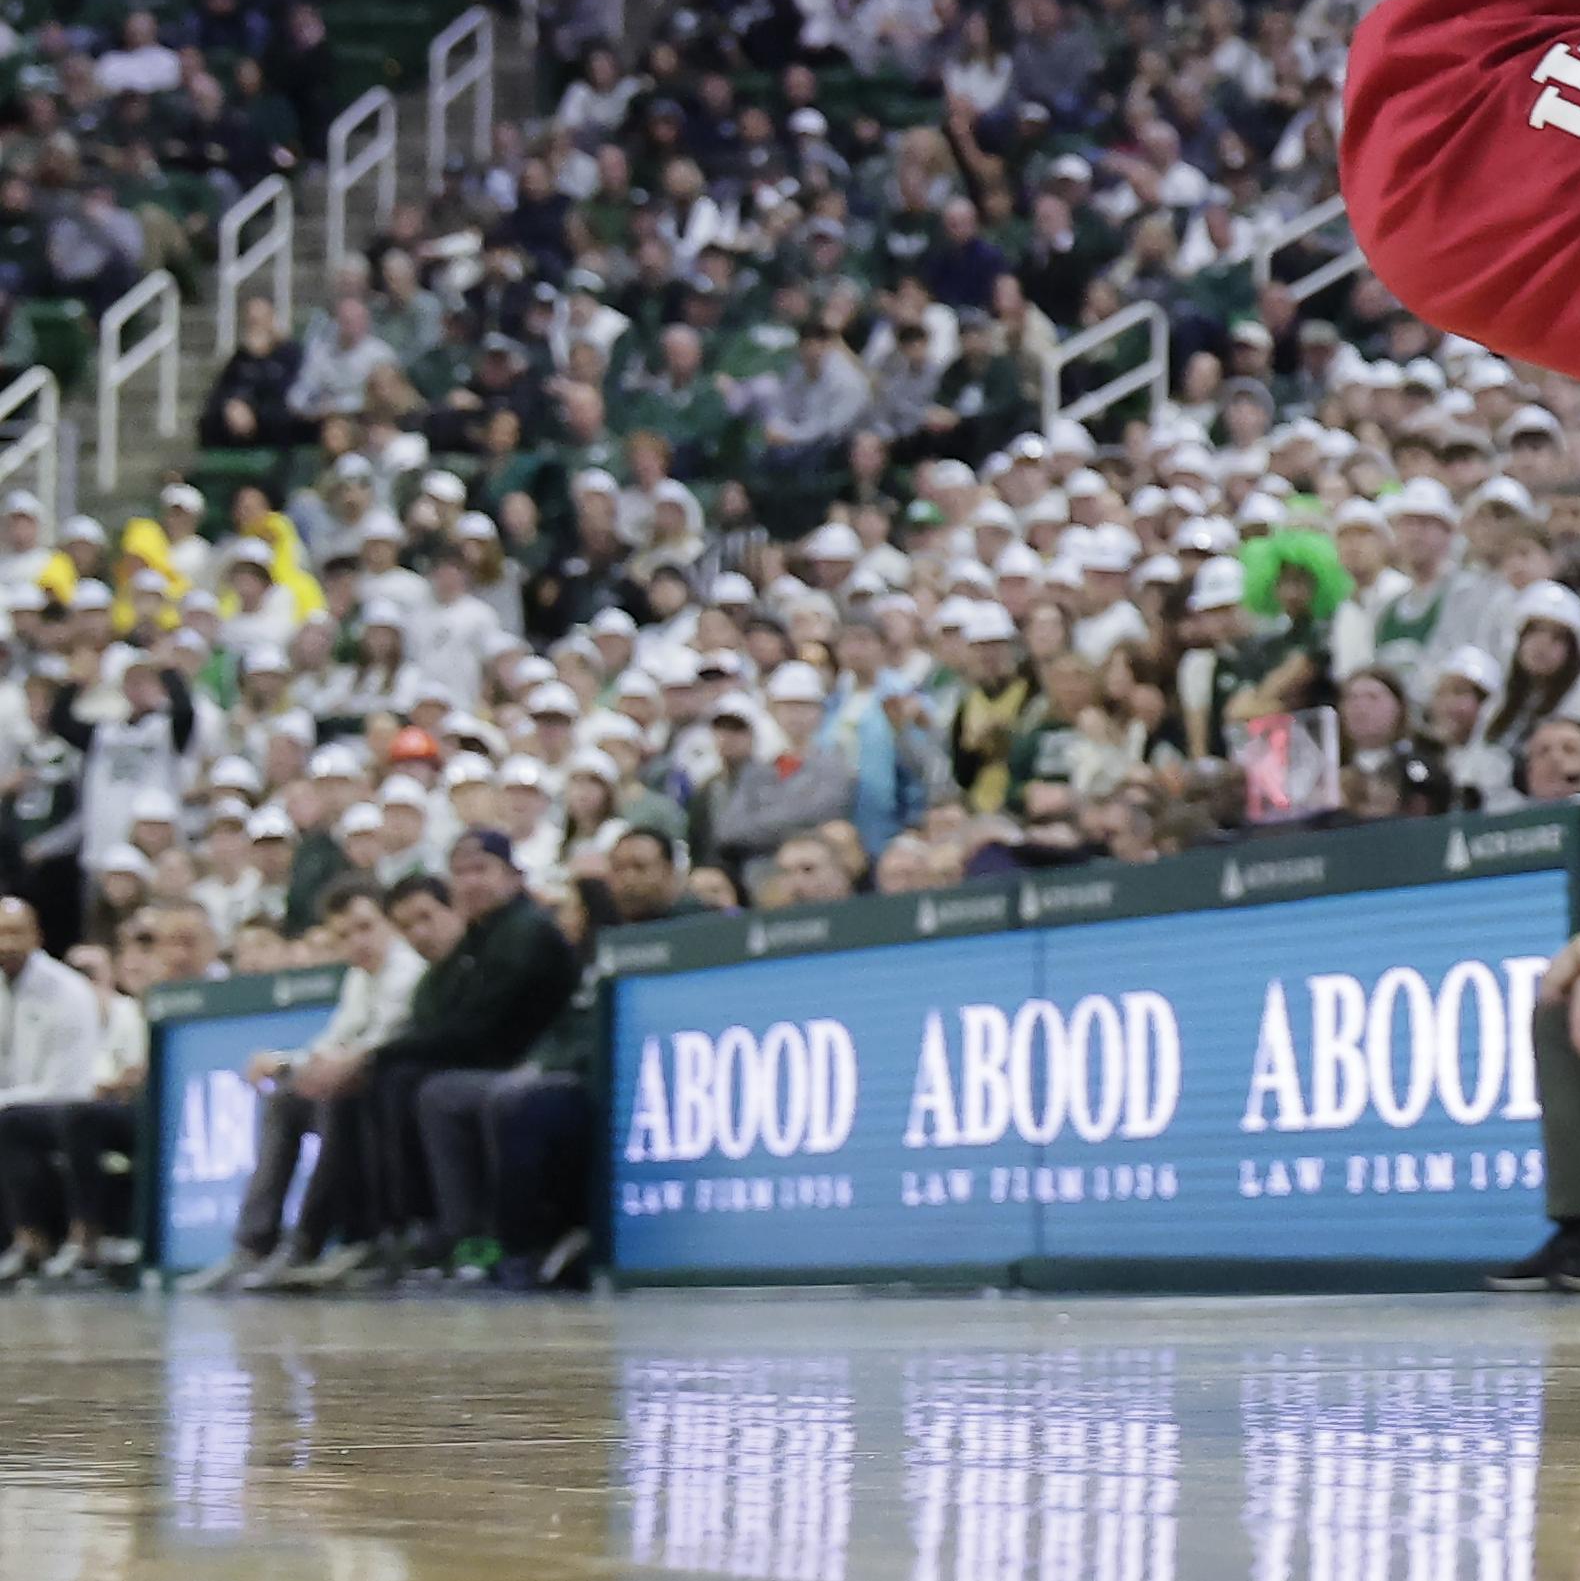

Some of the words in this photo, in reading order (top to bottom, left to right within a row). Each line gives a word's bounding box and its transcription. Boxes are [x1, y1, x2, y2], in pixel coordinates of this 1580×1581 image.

[624, 1018, 858, 1162] ABOOD
[900, 988, 1183, 1149] ABOOD
[1239, 1156, 1325, 1198] LAW
[1347, 1151, 1456, 1195] FIRM
[1470, 1148, 1544, 1191] 195
